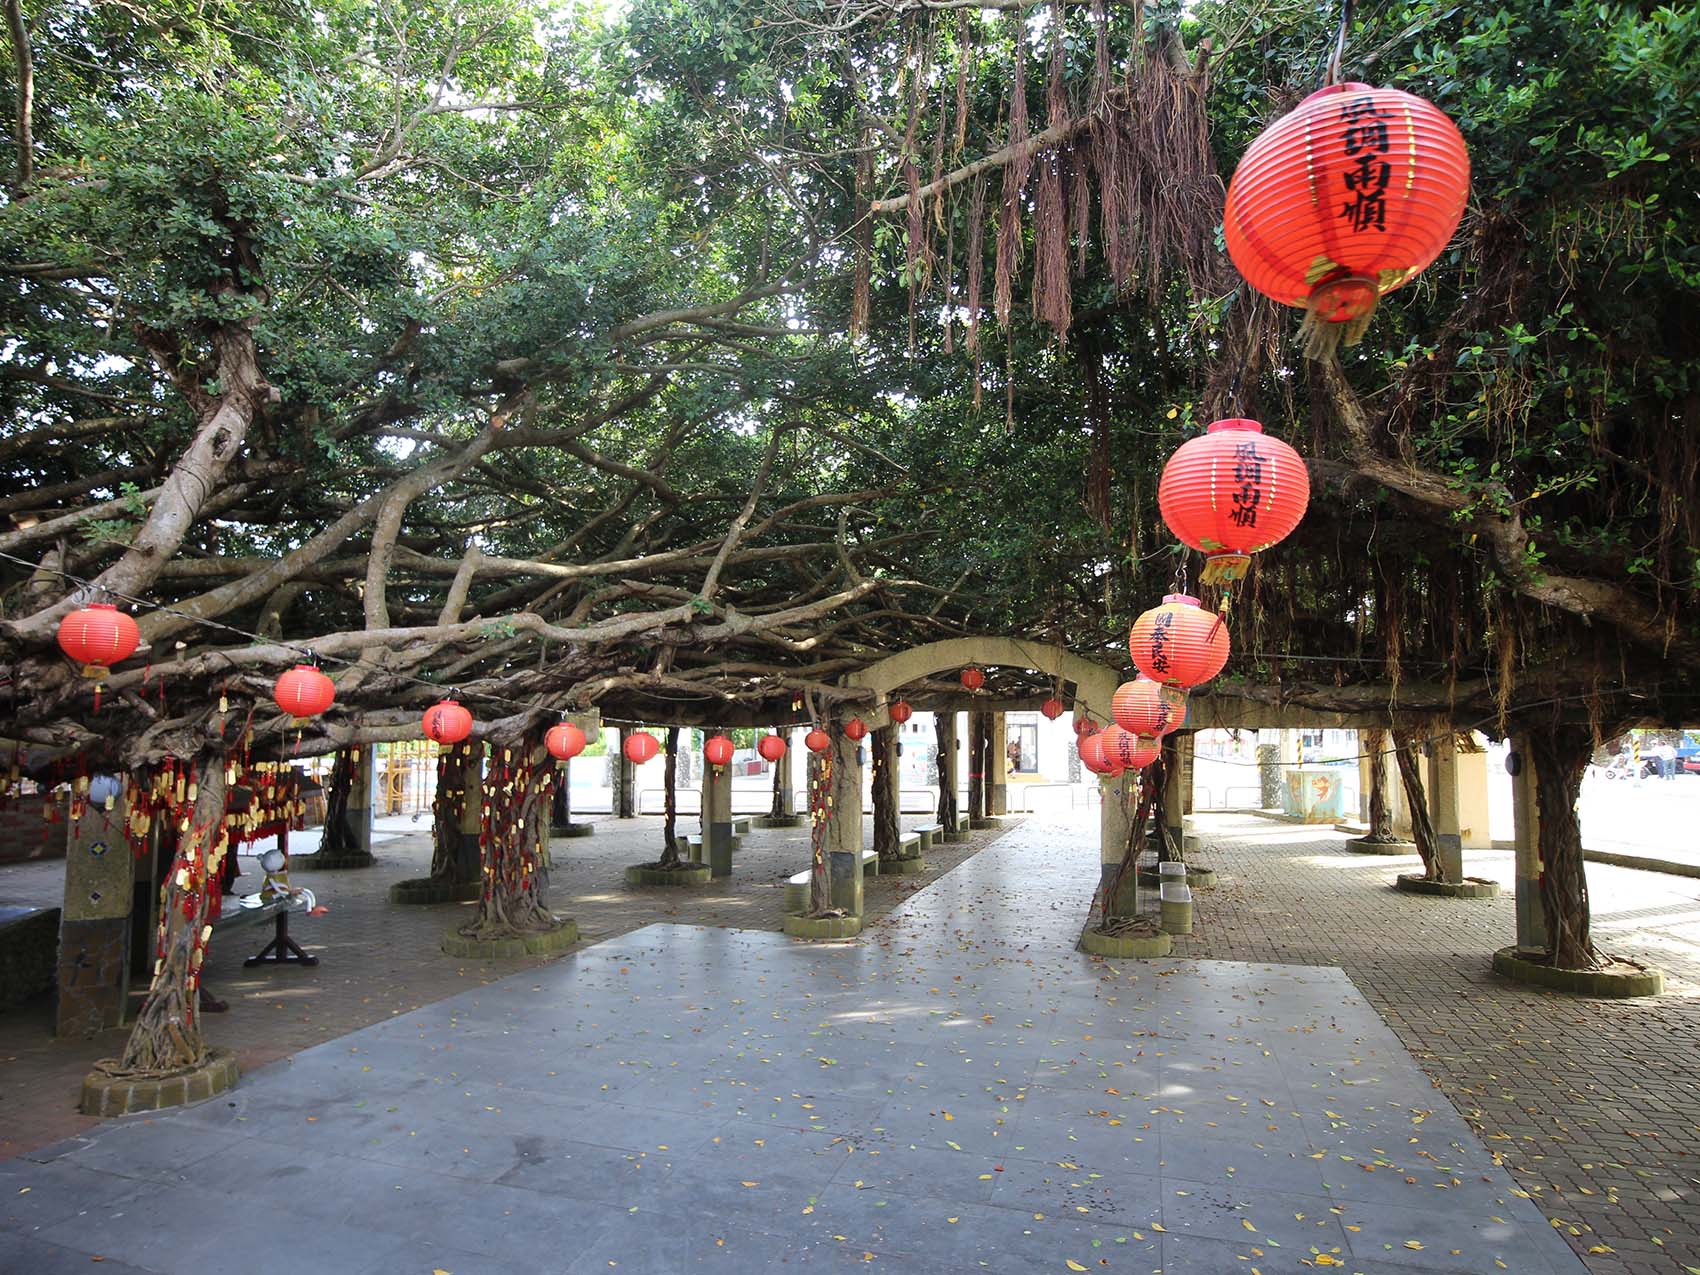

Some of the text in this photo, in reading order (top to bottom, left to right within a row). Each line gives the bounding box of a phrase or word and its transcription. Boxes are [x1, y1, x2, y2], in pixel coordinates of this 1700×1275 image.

[1338, 96, 1395, 233] 風調雨順
[1228, 441, 1267, 528] 風調雨順
